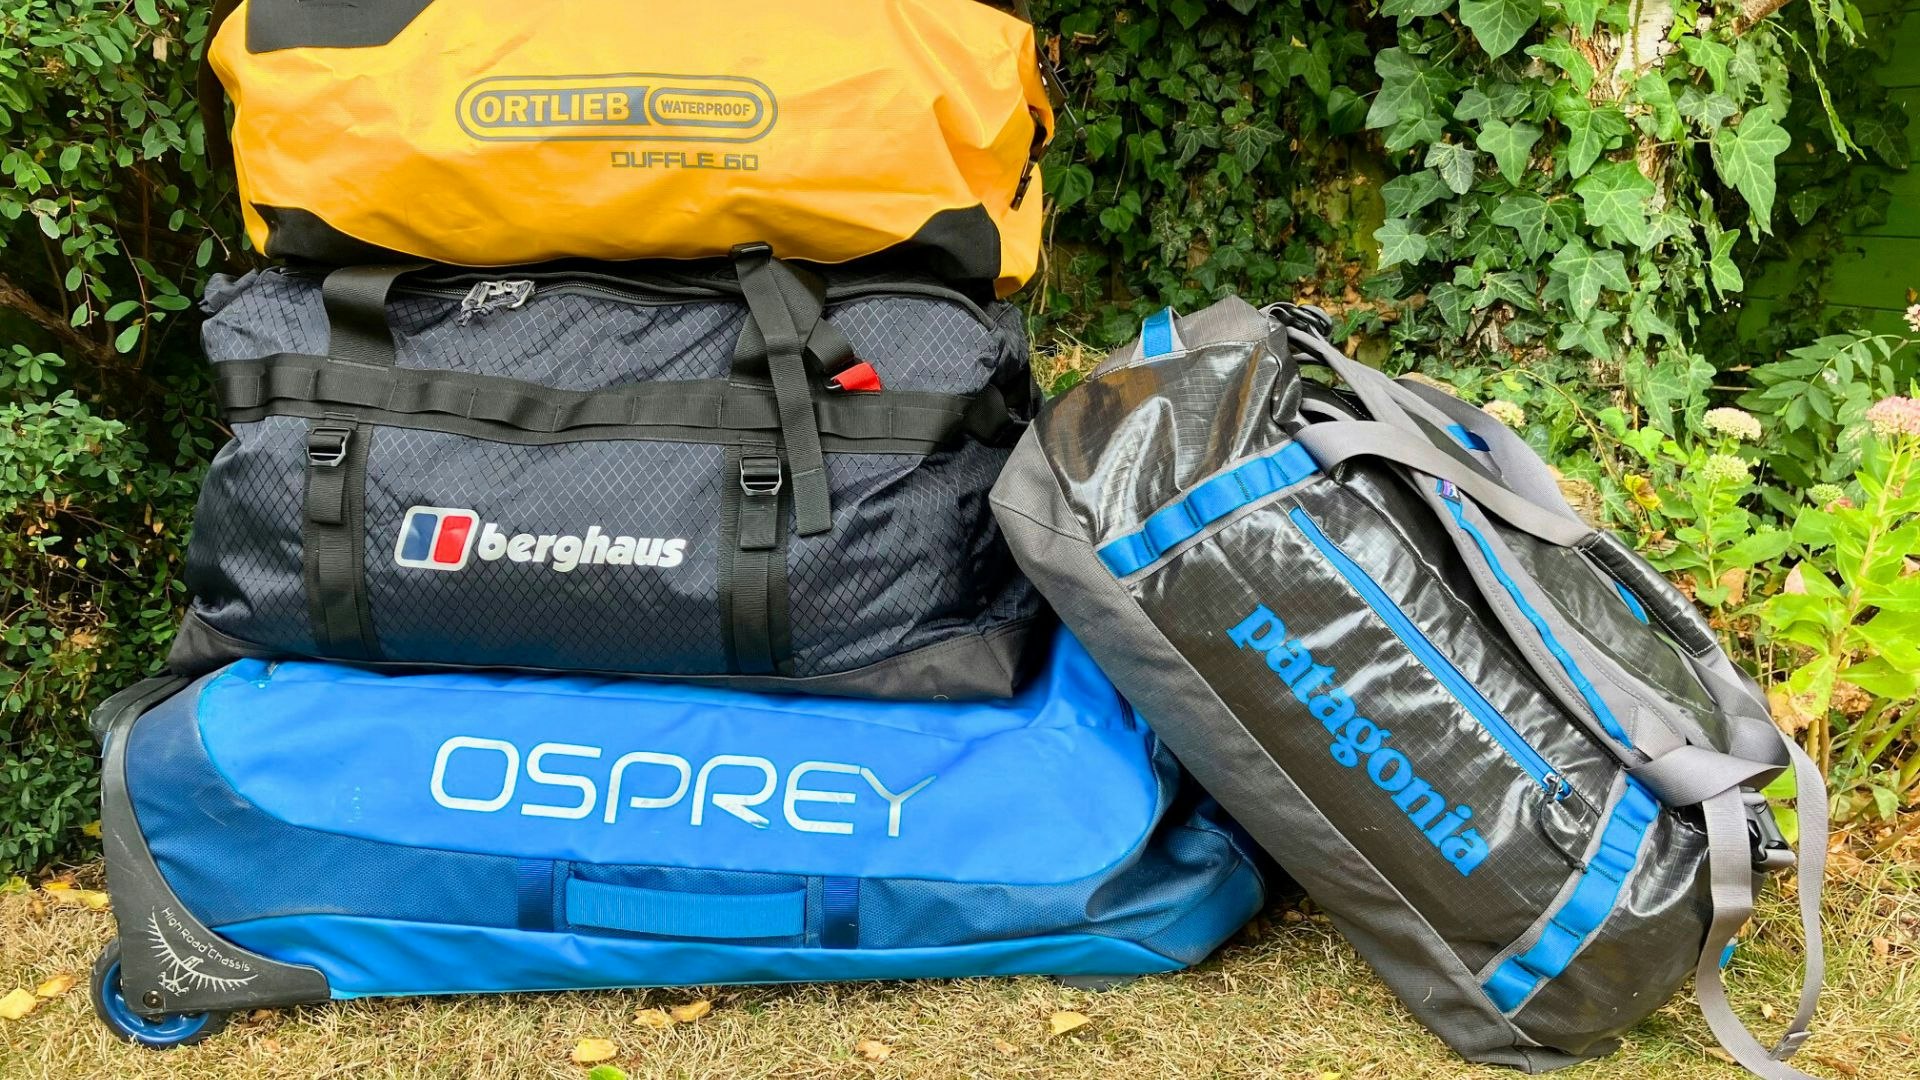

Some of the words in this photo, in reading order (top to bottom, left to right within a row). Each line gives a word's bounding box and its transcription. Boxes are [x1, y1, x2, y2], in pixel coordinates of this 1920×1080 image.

[475, 92, 631, 123] ORTLIEB
[661, 100, 751, 117] WATERPROOF
[611, 152, 714, 169] DUFFLE
[724, 154, 759, 171] 60
[477, 522, 687, 573] berghaus
[1226, 603, 1490, 878] patagonia
[430, 736, 937, 838] OSPREY
[161, 907, 183, 932] High
[207, 948, 251, 973] Chassis
